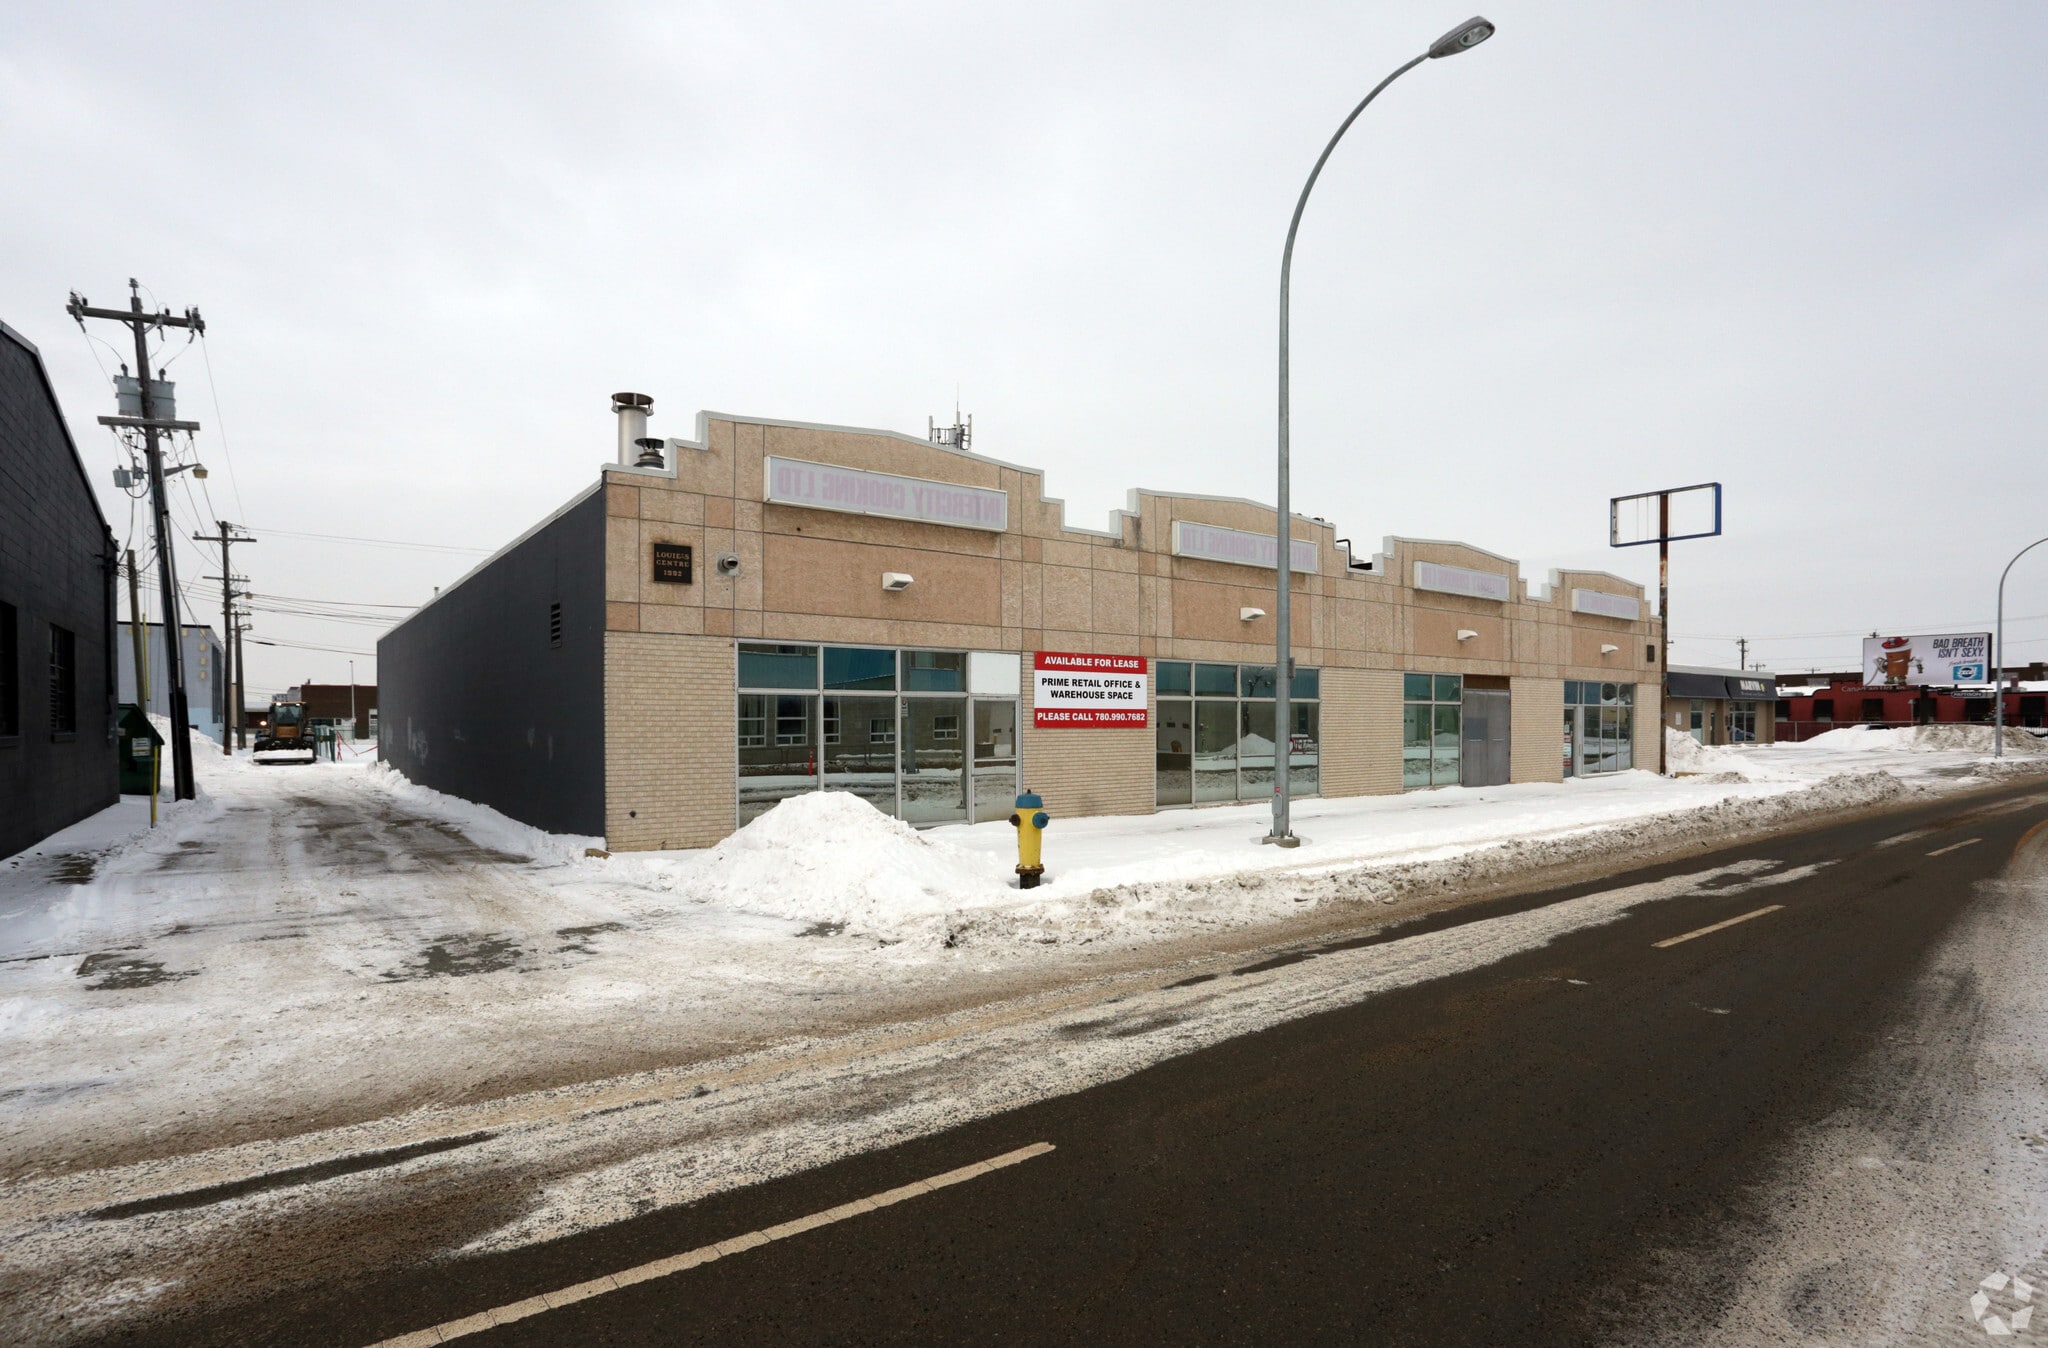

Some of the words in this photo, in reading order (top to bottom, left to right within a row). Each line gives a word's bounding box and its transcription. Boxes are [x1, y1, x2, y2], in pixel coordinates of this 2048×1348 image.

[1933, 638, 1949, 649] BAD
[1951, 637, 1985, 648] BREATH
[1937, 648, 1959, 658] ISN'T
[1044, 656, 1093, 667] AVAILABLE
[1094, 658, 1112, 667] FOR
[1113, 659, 1139, 669] LEASE
[1041, 678, 1069, 687] PRIME
[1071, 679, 1102, 688] RETAIL
[1103, 680, 1133, 688] OFFICE
[1134, 680, 1141, 689] &
[1050, 690, 1105, 699] WAREHOUSE
[1107, 691, 1133, 700] SPACE
[1037, 712, 1070, 721] PLEASE
[1072, 712, 1093, 721] CALL
